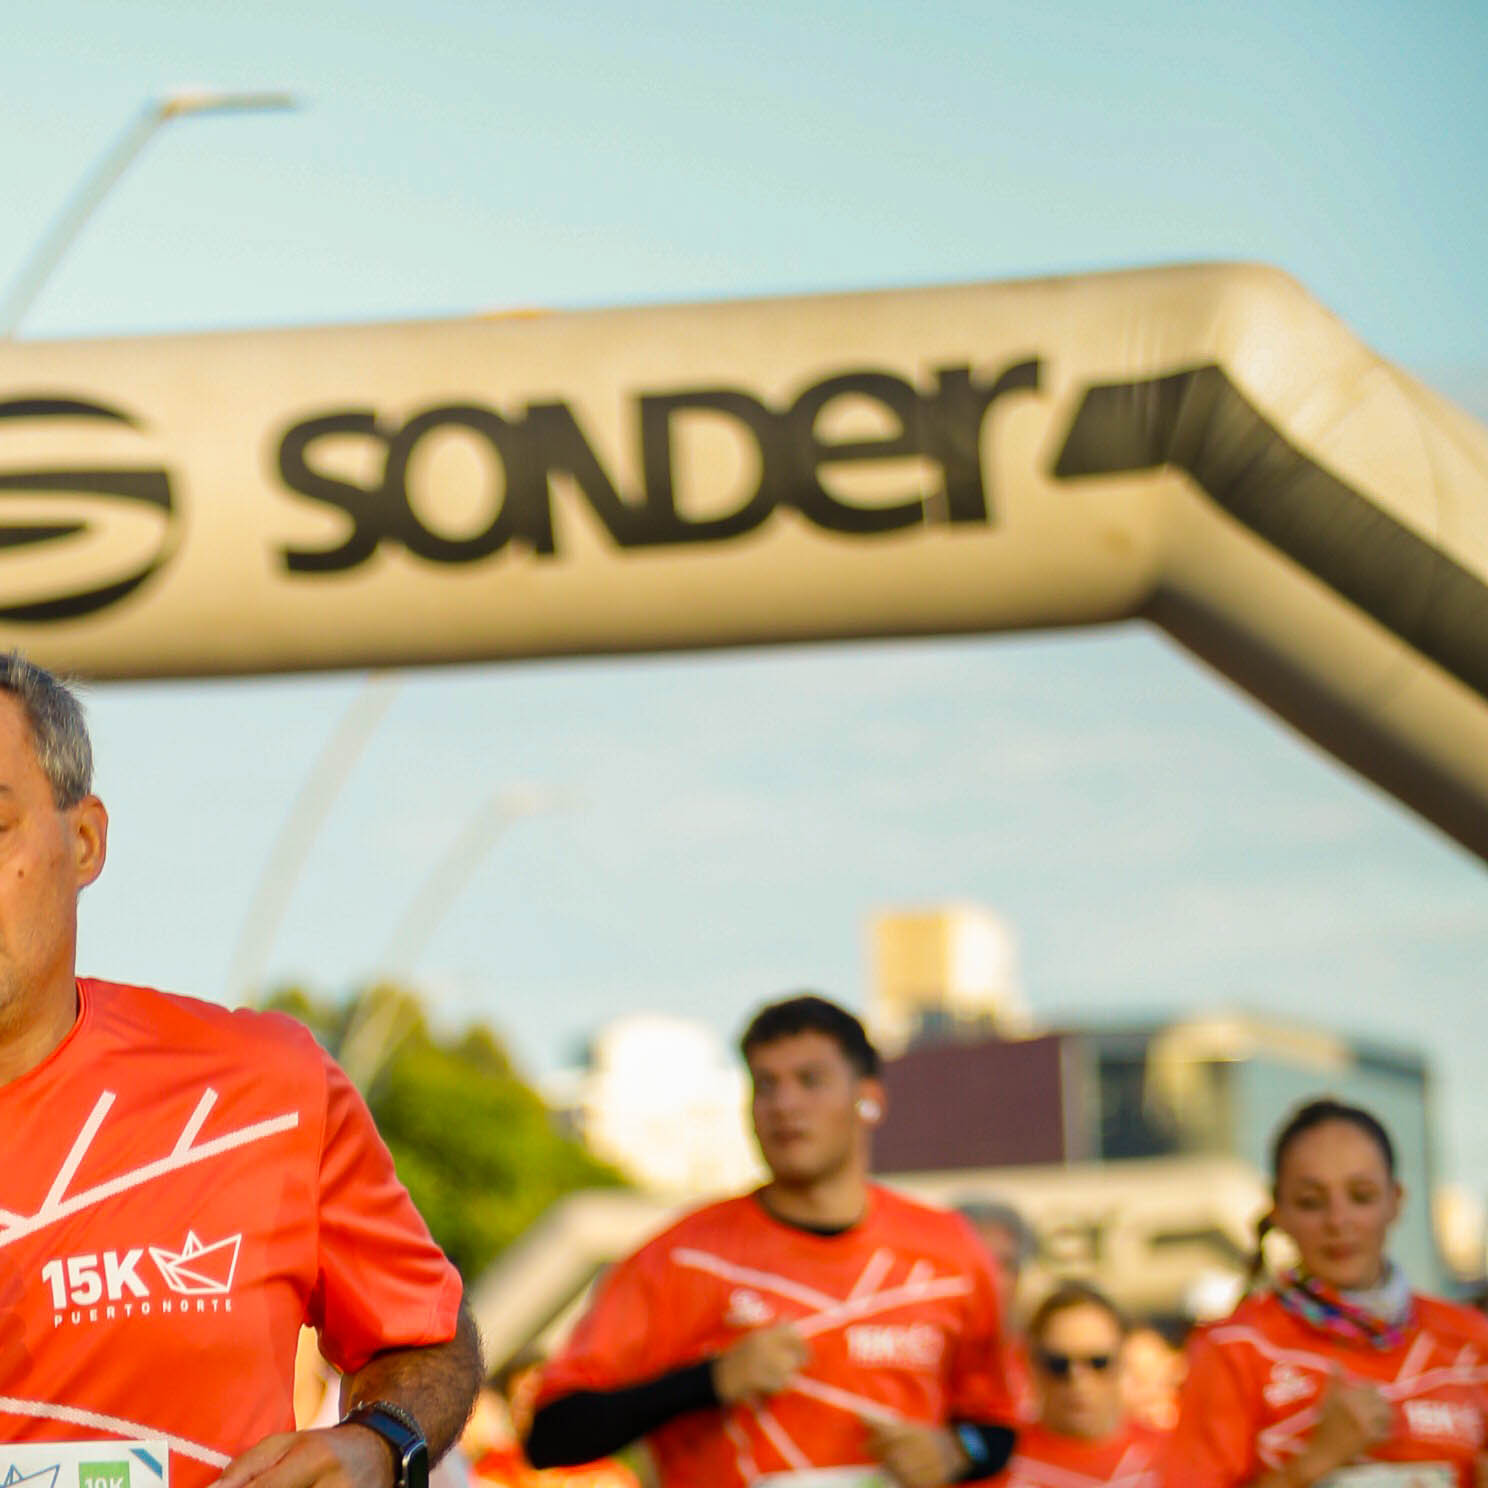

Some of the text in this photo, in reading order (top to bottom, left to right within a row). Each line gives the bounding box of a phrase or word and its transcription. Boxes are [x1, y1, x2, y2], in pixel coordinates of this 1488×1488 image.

[41, 1249, 150, 1310] 15K
[54, 1298, 232, 1328] PUERTO NORTE
